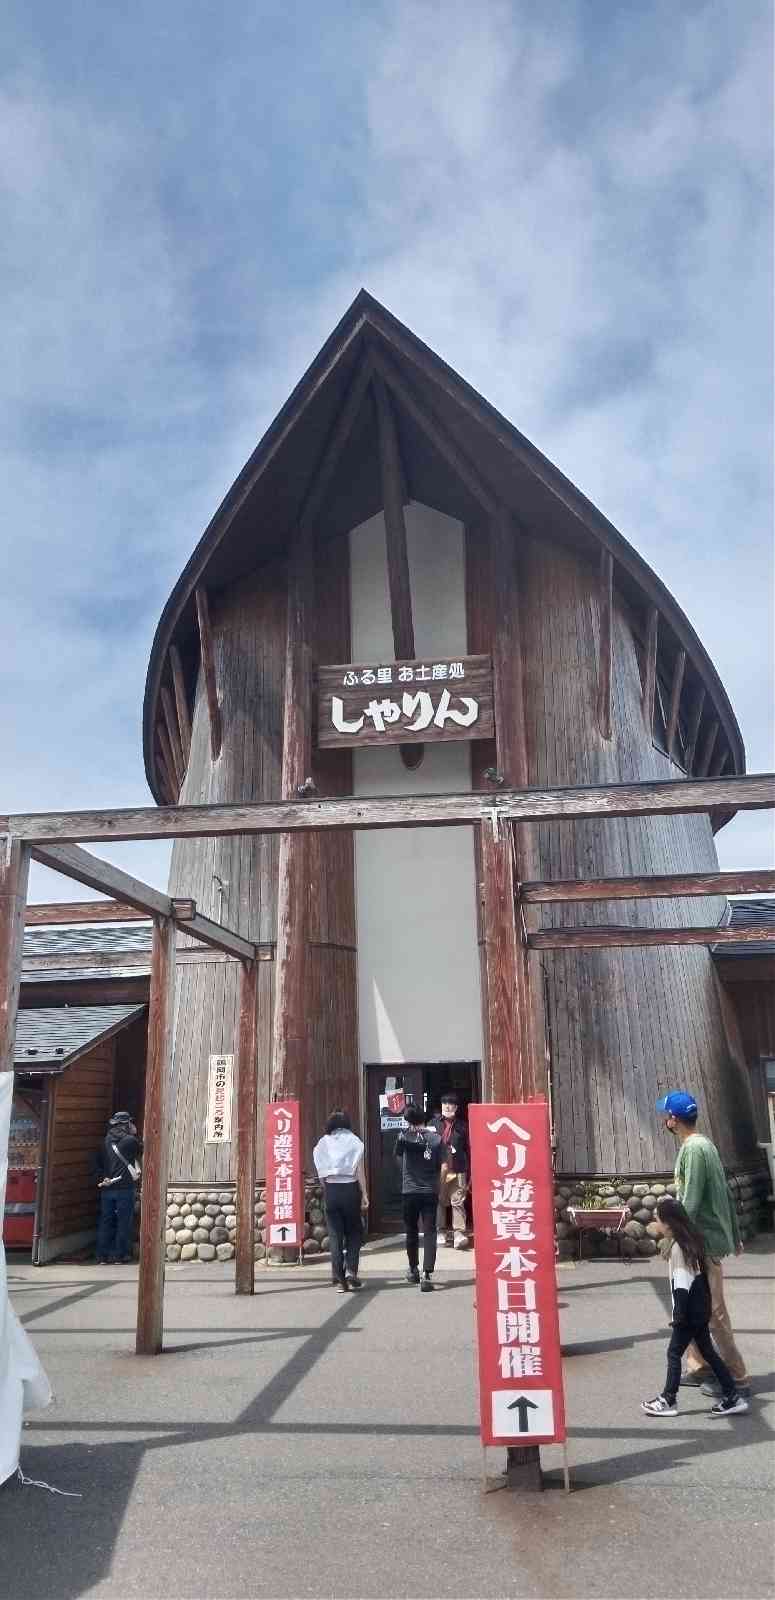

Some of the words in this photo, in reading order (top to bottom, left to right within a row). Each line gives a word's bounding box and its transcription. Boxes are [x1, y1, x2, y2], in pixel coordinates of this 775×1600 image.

[343, 667, 393, 686] ふる里
[398, 662, 465, 682] お土産処
[331, 688, 479, 733] しゃりん
